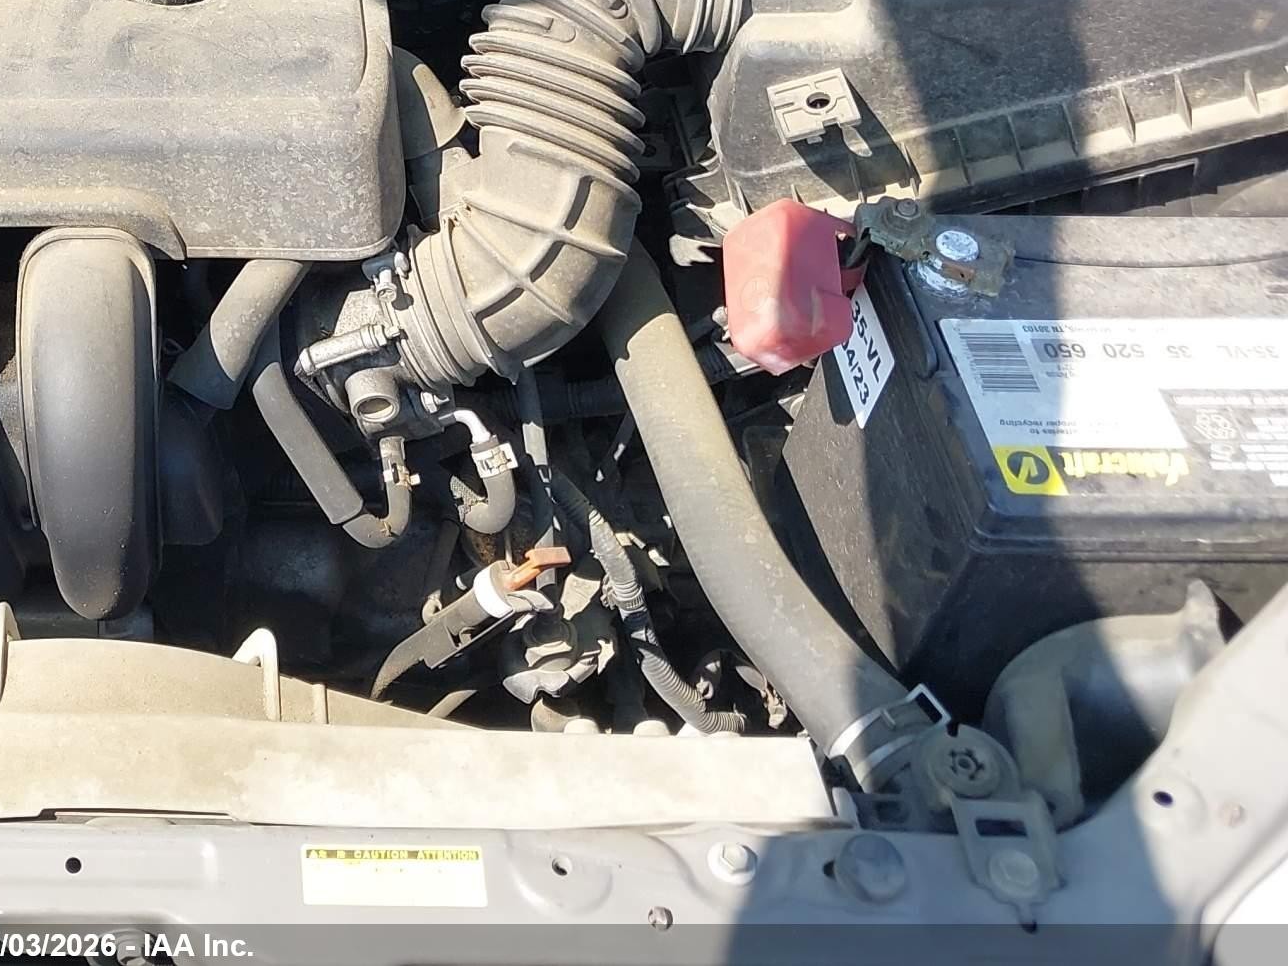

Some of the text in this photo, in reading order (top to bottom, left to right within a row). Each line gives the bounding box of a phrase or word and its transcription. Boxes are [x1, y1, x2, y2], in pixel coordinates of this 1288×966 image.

[851, 300, 882, 385] 35-VL
[1043, 342, 1087, 359] 650
[1102, 342, 1145, 359] 520
[1166, 344, 1193, 359] 35
[999, 418, 1043, 427] recycling
[354, 849, 409, 859] CAUTION
[416, 850, 476, 860] ATTENTION
